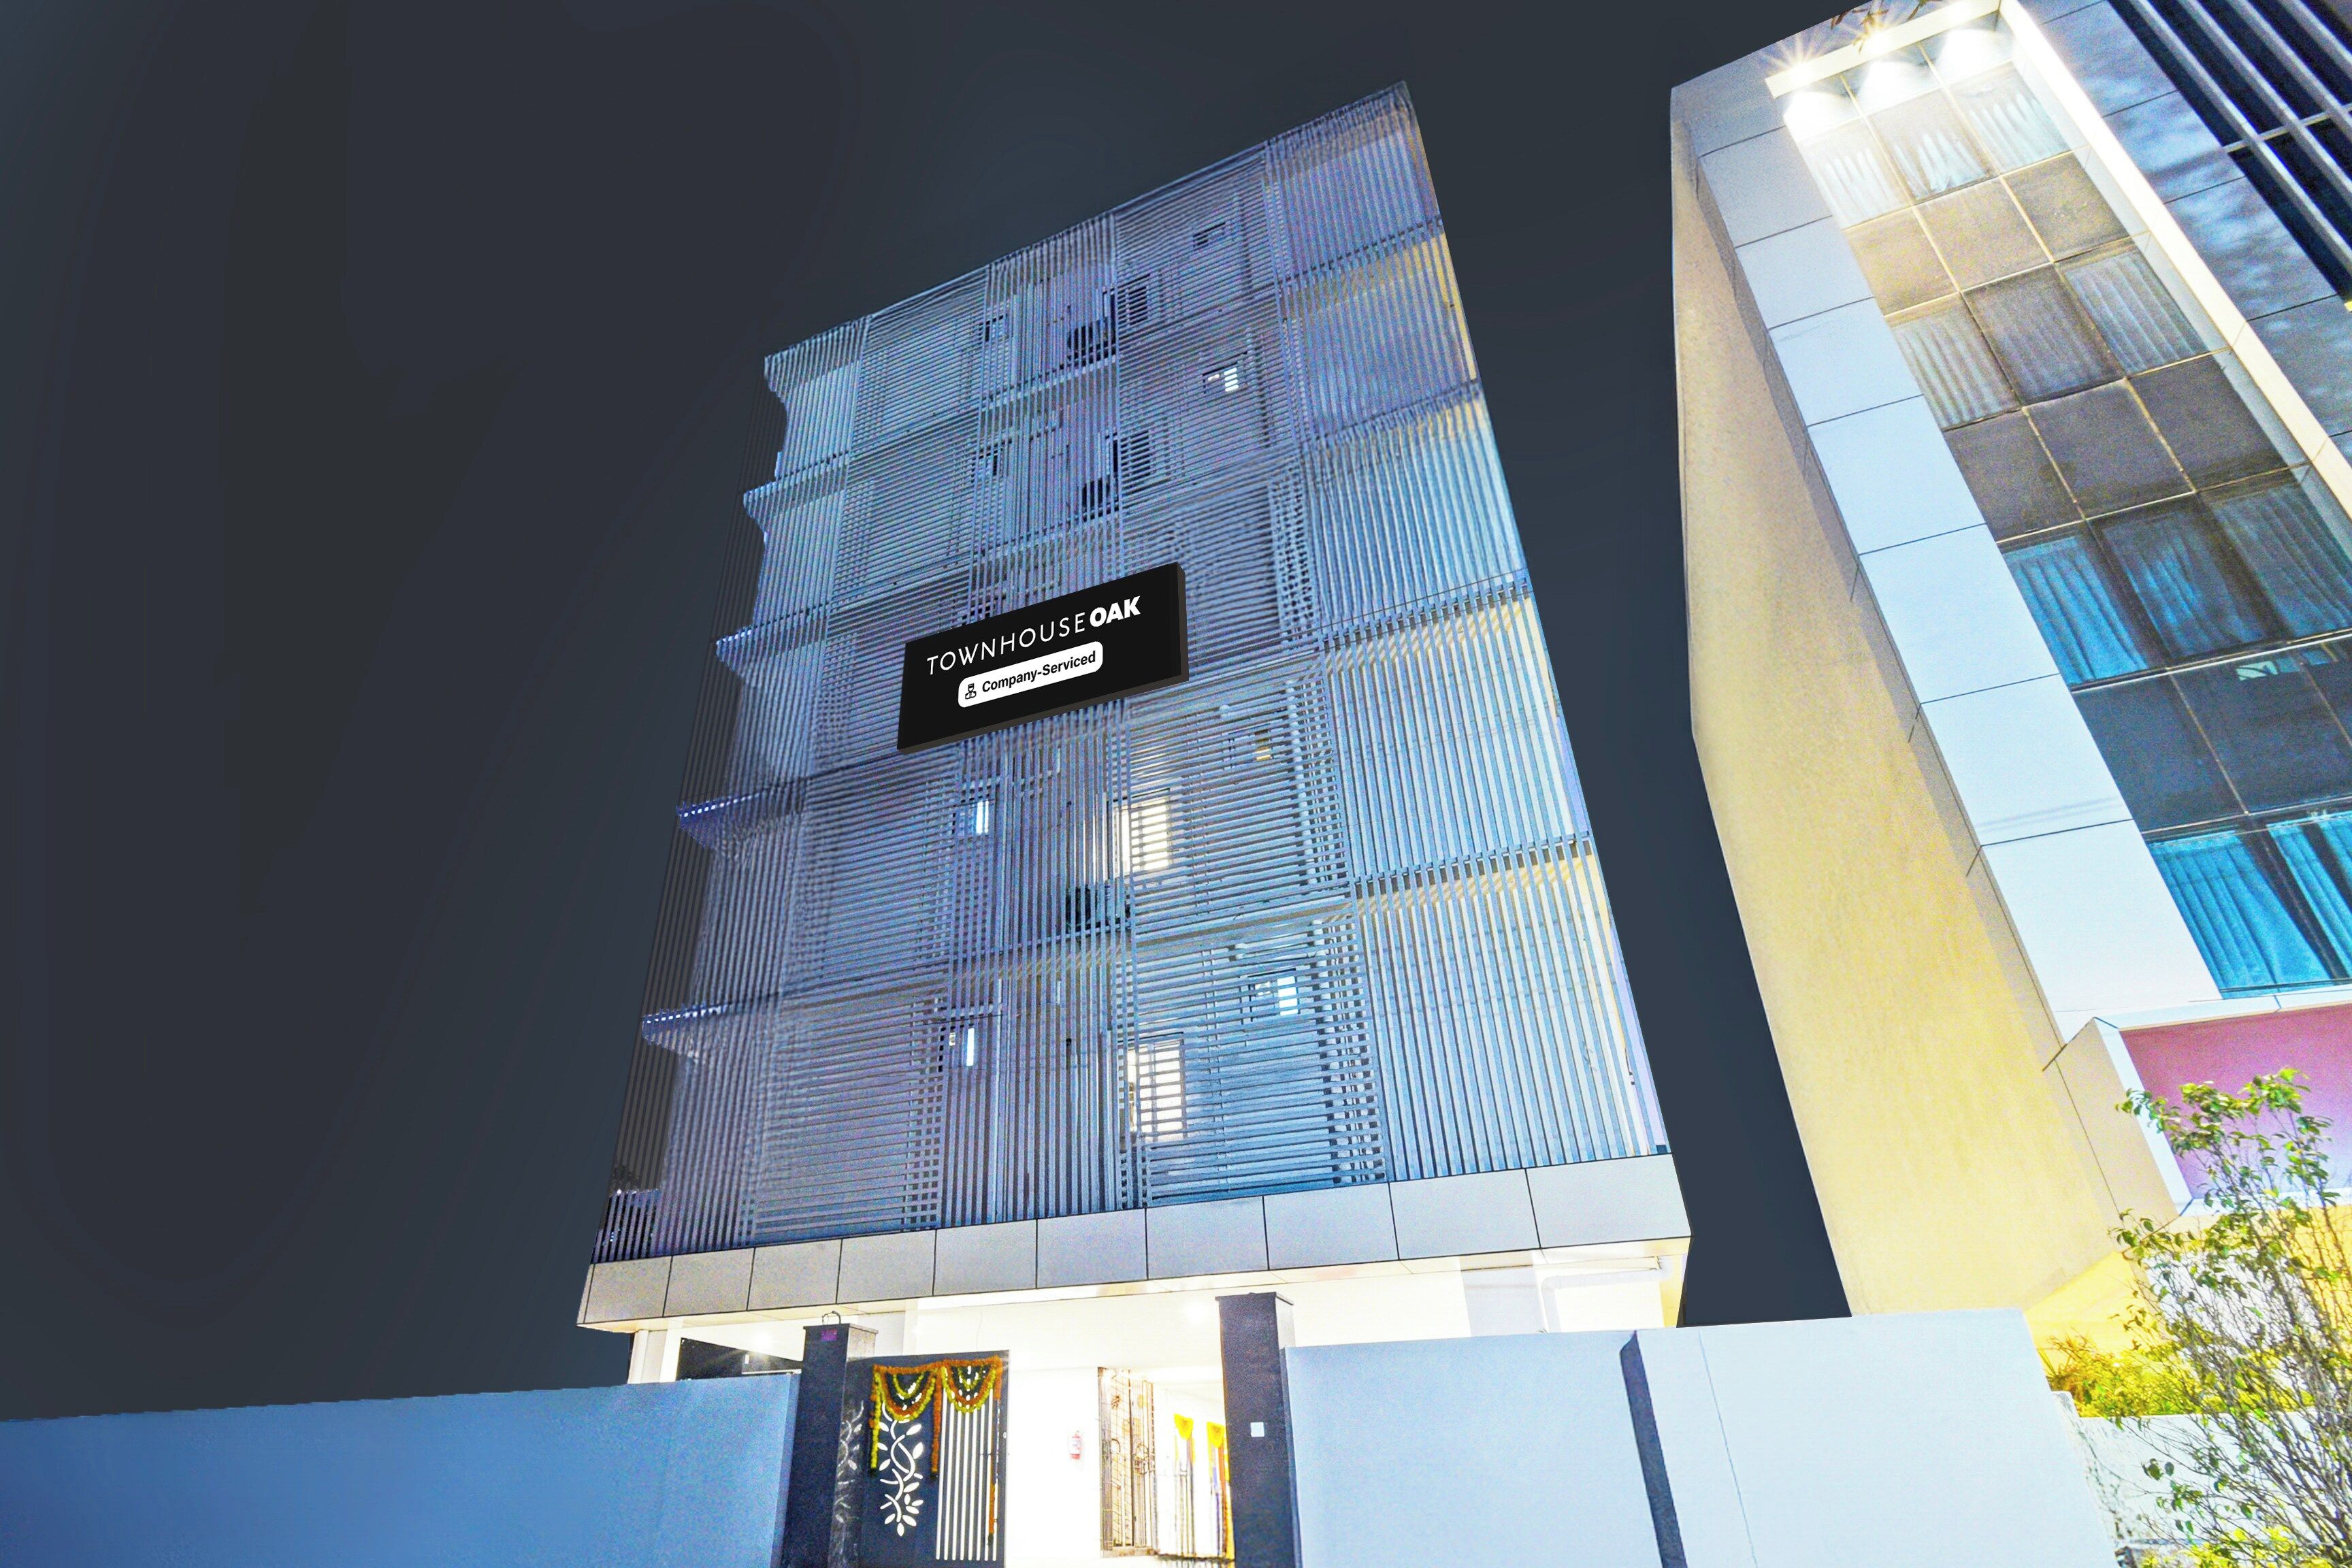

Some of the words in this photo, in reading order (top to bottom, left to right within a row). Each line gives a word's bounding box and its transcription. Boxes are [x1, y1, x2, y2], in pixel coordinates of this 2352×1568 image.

[926, 612, 1085, 675] TOWNHOUSE
[1090, 595, 1141, 627] OAK
[982, 650, 1096, 693] Company-Serviced
